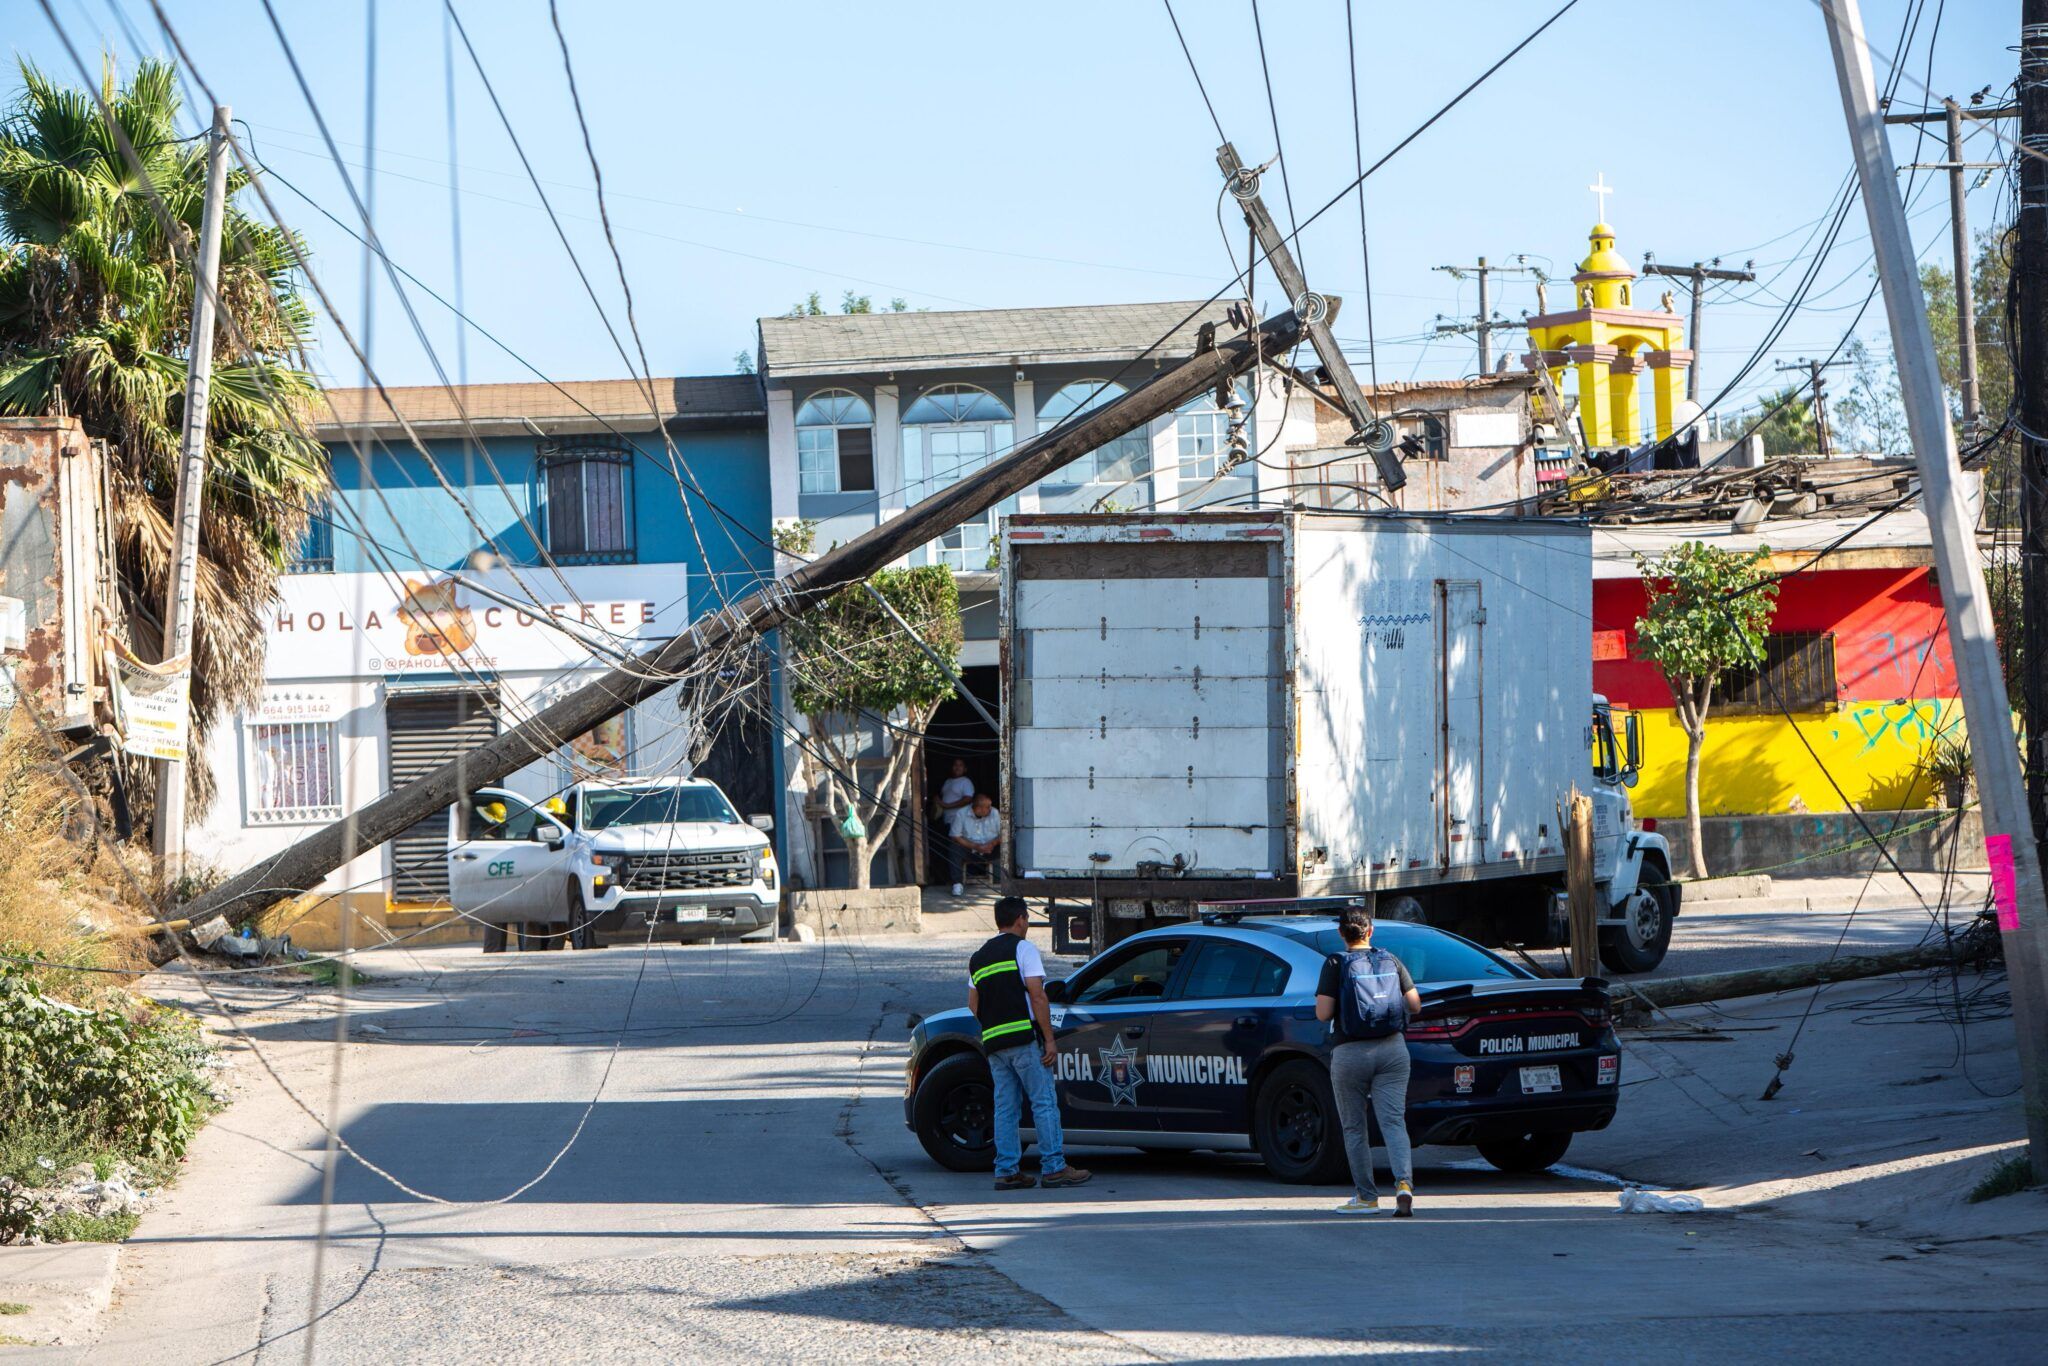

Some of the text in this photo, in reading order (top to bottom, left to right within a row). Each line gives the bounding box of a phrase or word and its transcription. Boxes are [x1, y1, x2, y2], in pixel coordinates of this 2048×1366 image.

[277, 602, 656, 632] HOLA COFFEE
[384, 657, 498, 670] @PAHOLACOFFEE
[263, 703, 331, 715] 664 915 1442
[488, 861, 515, 876] CFE
[1479, 1032, 1581, 1054] POLICÍA MUNICIPAL
[1146, 1054, 1248, 1085] MUNICIPAL
